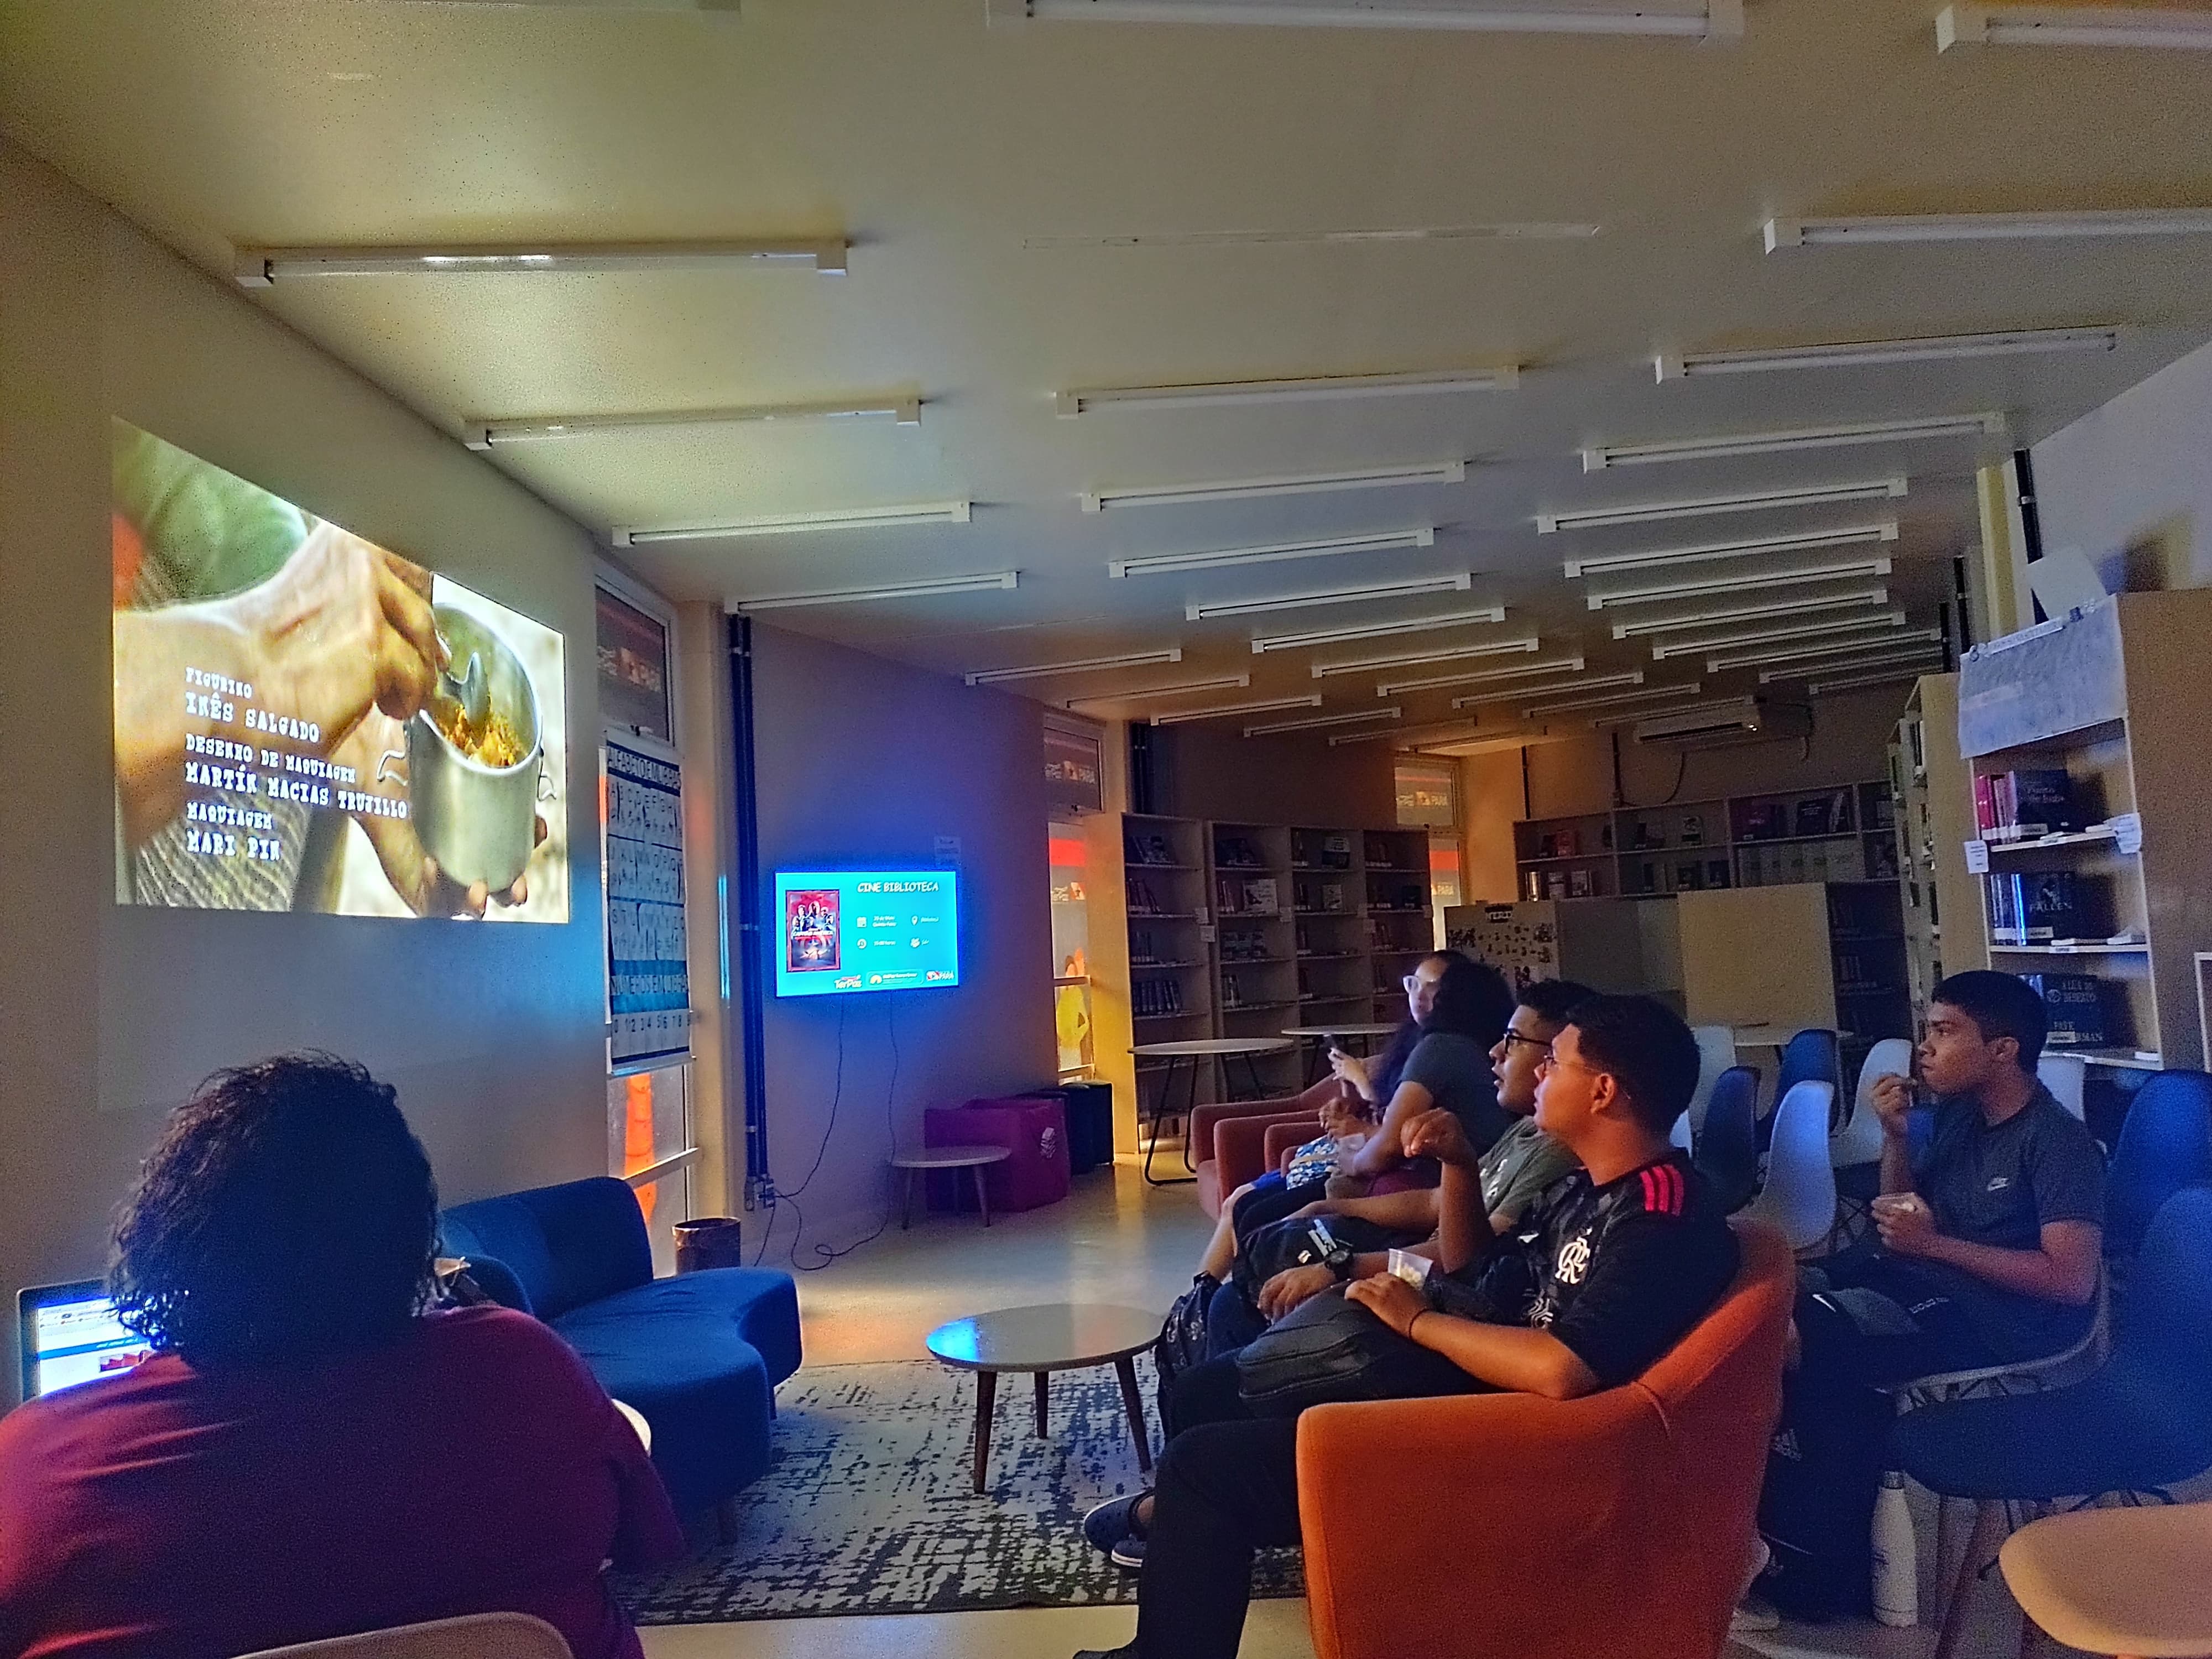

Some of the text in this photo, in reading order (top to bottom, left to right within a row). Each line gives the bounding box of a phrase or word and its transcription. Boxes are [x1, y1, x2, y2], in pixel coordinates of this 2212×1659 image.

[185, 666, 252, 699] FIGURINO
[185, 691, 320, 743] INÊS SALGADO
[185, 734, 356, 784] DESENHO DE MAQUIAGEM
[185, 761, 408, 819] MARTÍN MACIAS TRUJILLO
[187, 802, 272, 830] MAQUIAGEM
[187, 828, 280, 860] MARI PIN
[857, 881, 939, 893] CINE BIBLIOTECA
